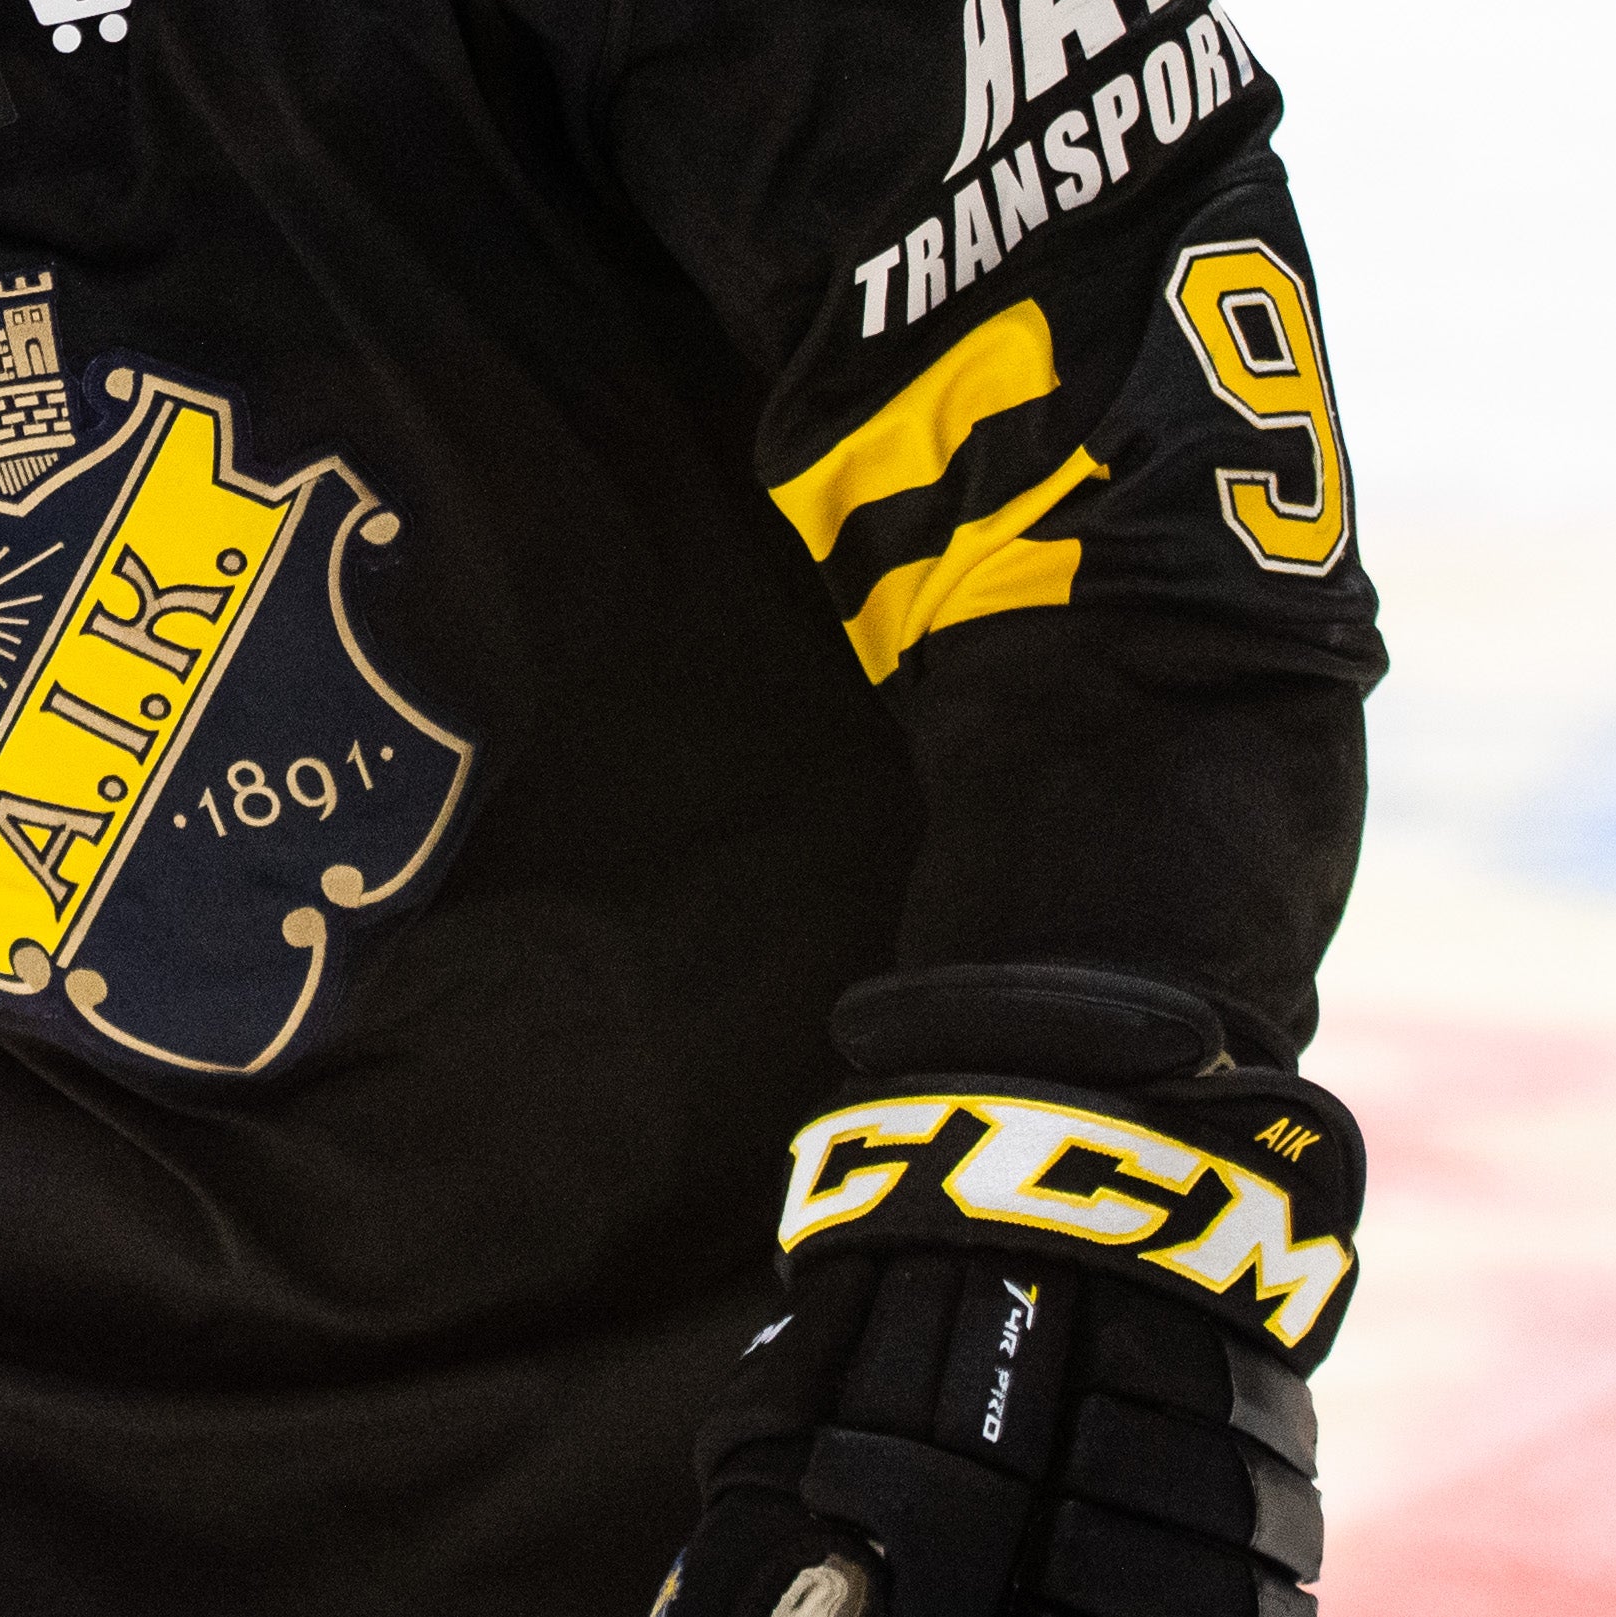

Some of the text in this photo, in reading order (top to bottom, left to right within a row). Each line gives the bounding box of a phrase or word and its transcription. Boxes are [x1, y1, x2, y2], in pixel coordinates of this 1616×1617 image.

[1166, 238, 1351, 578] 9
[777, 1093, 1355, 1349] CCM
[1254, 1117, 1321, 1163] AIK
[982, 1366, 1011, 1444] PRO
